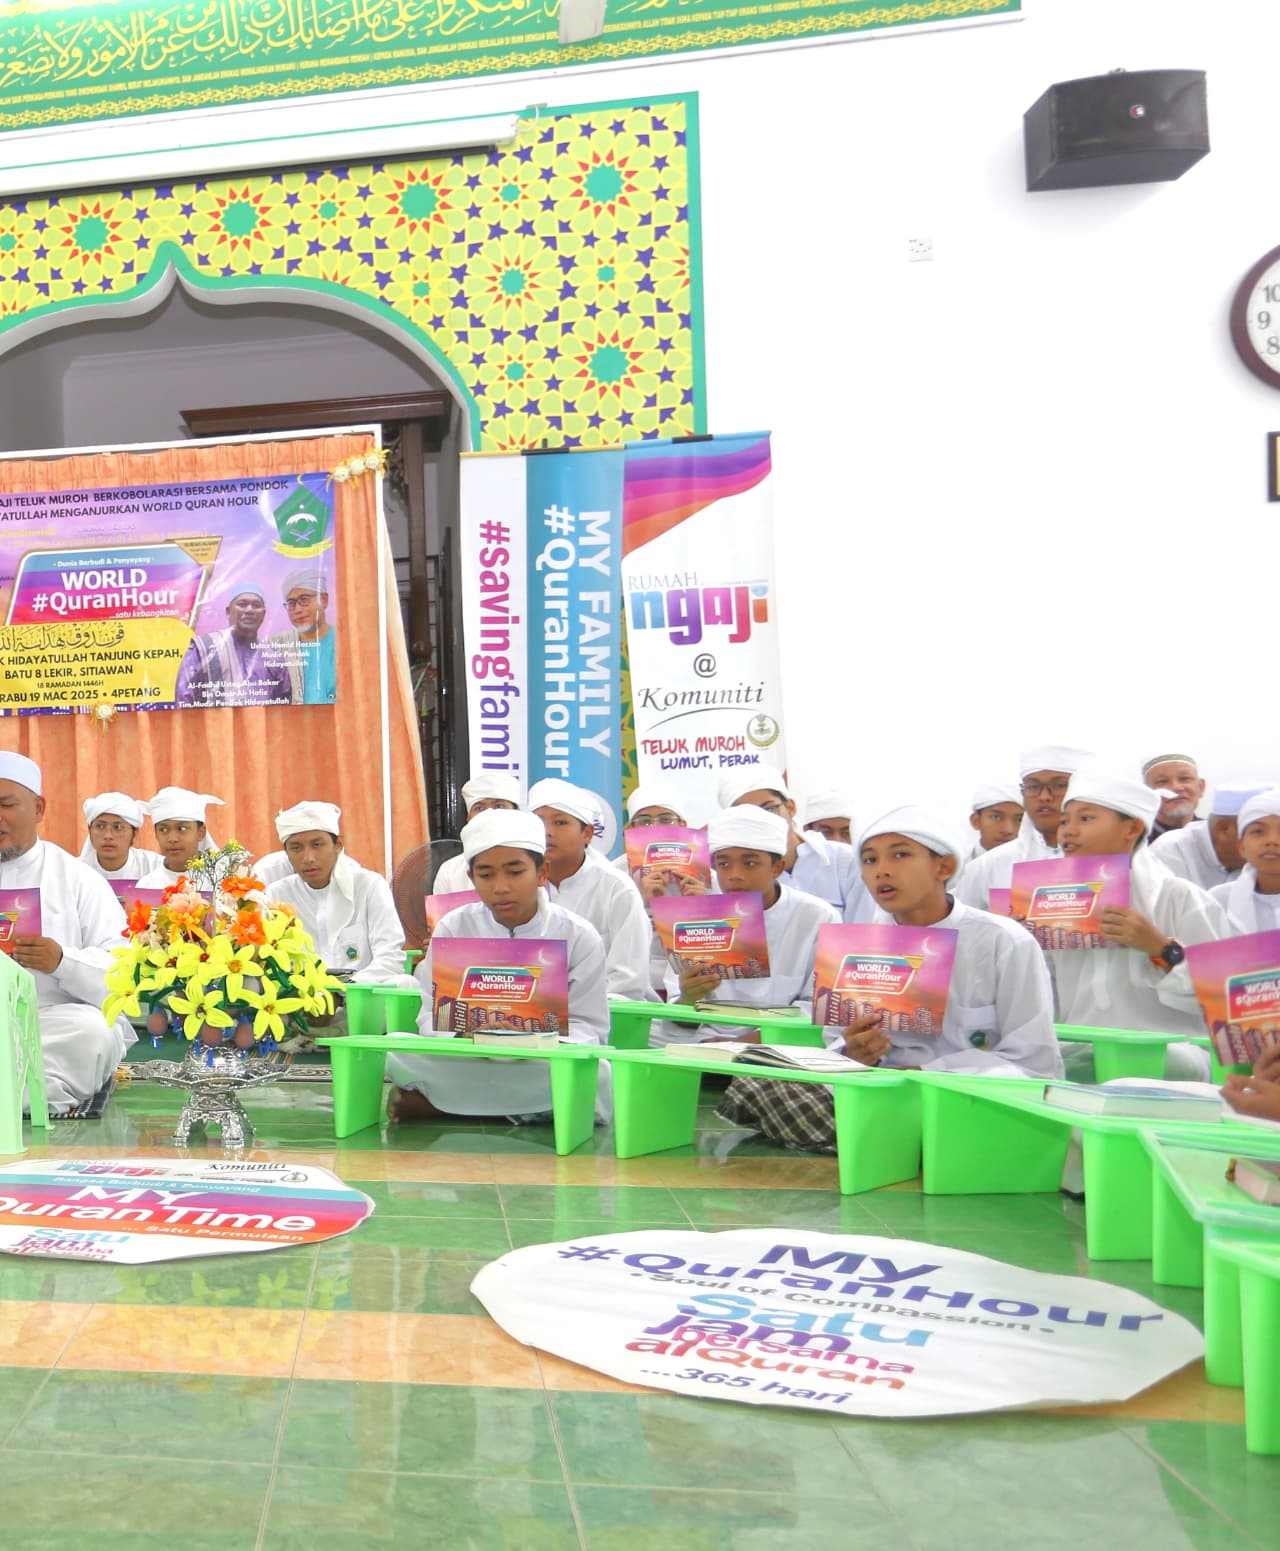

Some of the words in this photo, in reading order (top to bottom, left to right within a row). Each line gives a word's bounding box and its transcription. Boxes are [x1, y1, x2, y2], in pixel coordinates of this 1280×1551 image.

[1257, 311, 1271, 330] 9
[1267, 336, 1280, 355] 8
[14, 496, 46, 507] TELUK
[49, 493, 89, 505] MUROH
[93, 485, 183, 502] BERKOBOLARASI
[186, 483, 237, 497] BERSAMA
[240, 480, 288, 494] PONDOK
[50, 503, 140, 519] MENGANJURKAN
[142, 501, 182, 513] WORLD
[185, 498, 225, 511] QURAN
[227, 496, 258, 508] HOUR
[578, 510, 612, 577] MY
[61, 569, 147, 592] WORLD
[628, 571, 698, 590] RUMAH
[32, 589, 179, 615] #QuranHour
[630, 584, 769, 645] ngaji
[535, 504, 576, 778] #QuranHour
[7, 653, 87, 667] HIDAYATULLAH
[90, 650, 141, 662] TANJUNG
[143, 648, 183, 660] KEPAH,
[693, 653, 717, 678] @
[5, 668, 32, 680] BATU
[35, 668, 42, 679] 8
[44, 666, 77, 679] LEKIR,
[80, 664, 133, 677] SITIAWAN
[578, 591, 612, 759] FAMILY
[0, 692, 27, 703] RABU
[30, 691, 40, 702] 19
[43, 690, 68, 702] MAC
[71, 689, 99, 700] 2025
[111, 687, 161, 698] 4PETANG
[46, 680, 82, 689] RAMADAN
[638, 681, 764, 712] Komuniti
[641, 738, 689, 755] TELUK
[695, 735, 745, 753] MUROH
[661, 755, 713, 770] LUMUT,
[719, 754, 760, 767] PERAK
[678, 934, 726, 944] #QuranHour
[686, 928, 714, 936] WORLD
[481, 974, 515, 983] WORLD
[845, 971, 902, 982] #QuranHour
[856, 963, 891, 973] WORLD
[470, 981, 526, 991] #QuranHour
[66, 1185, 209, 1206] MY
[26, 1228, 131, 1244] Satu
[144, 1225, 192, 1235] Satu
[194, 1229, 305, 1242] Permulaan
[758, 1244, 944, 1283] My
[556, 1244, 1165, 1333] #QuranHour
[648, 1274, 731, 1289] Soul
[737, 1285, 777, 1296] of
[784, 1291, 1032, 1332] Compassion
[676, 1293, 934, 1347] Satu
[642, 1308, 852, 1354] jam
[671, 1326, 916, 1374] bersama
[759, 1380, 854, 1403] hari
